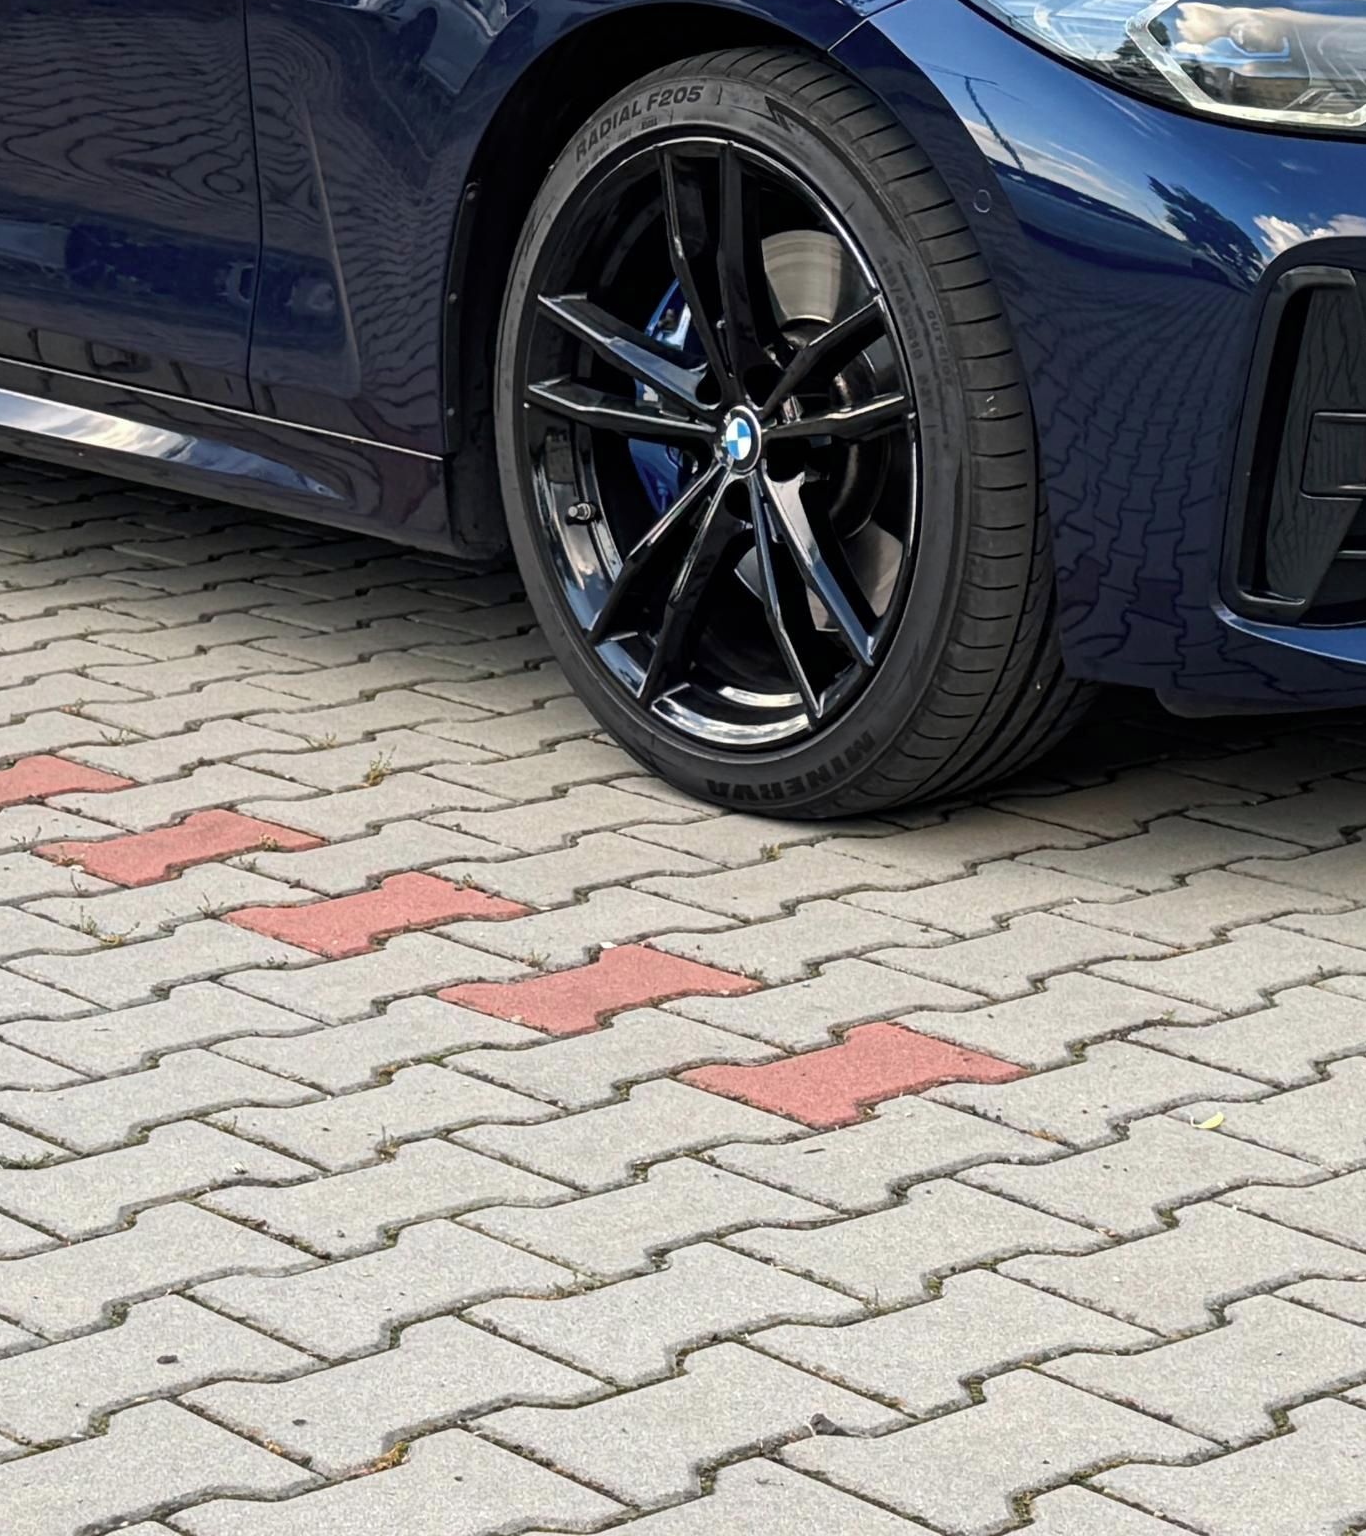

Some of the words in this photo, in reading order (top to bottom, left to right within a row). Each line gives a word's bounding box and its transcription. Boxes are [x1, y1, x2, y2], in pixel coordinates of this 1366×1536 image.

[576, 100, 644, 162] RADIAL
[646, 85, 705, 111] F205
[705, 730, 876, 801] MINERVA
